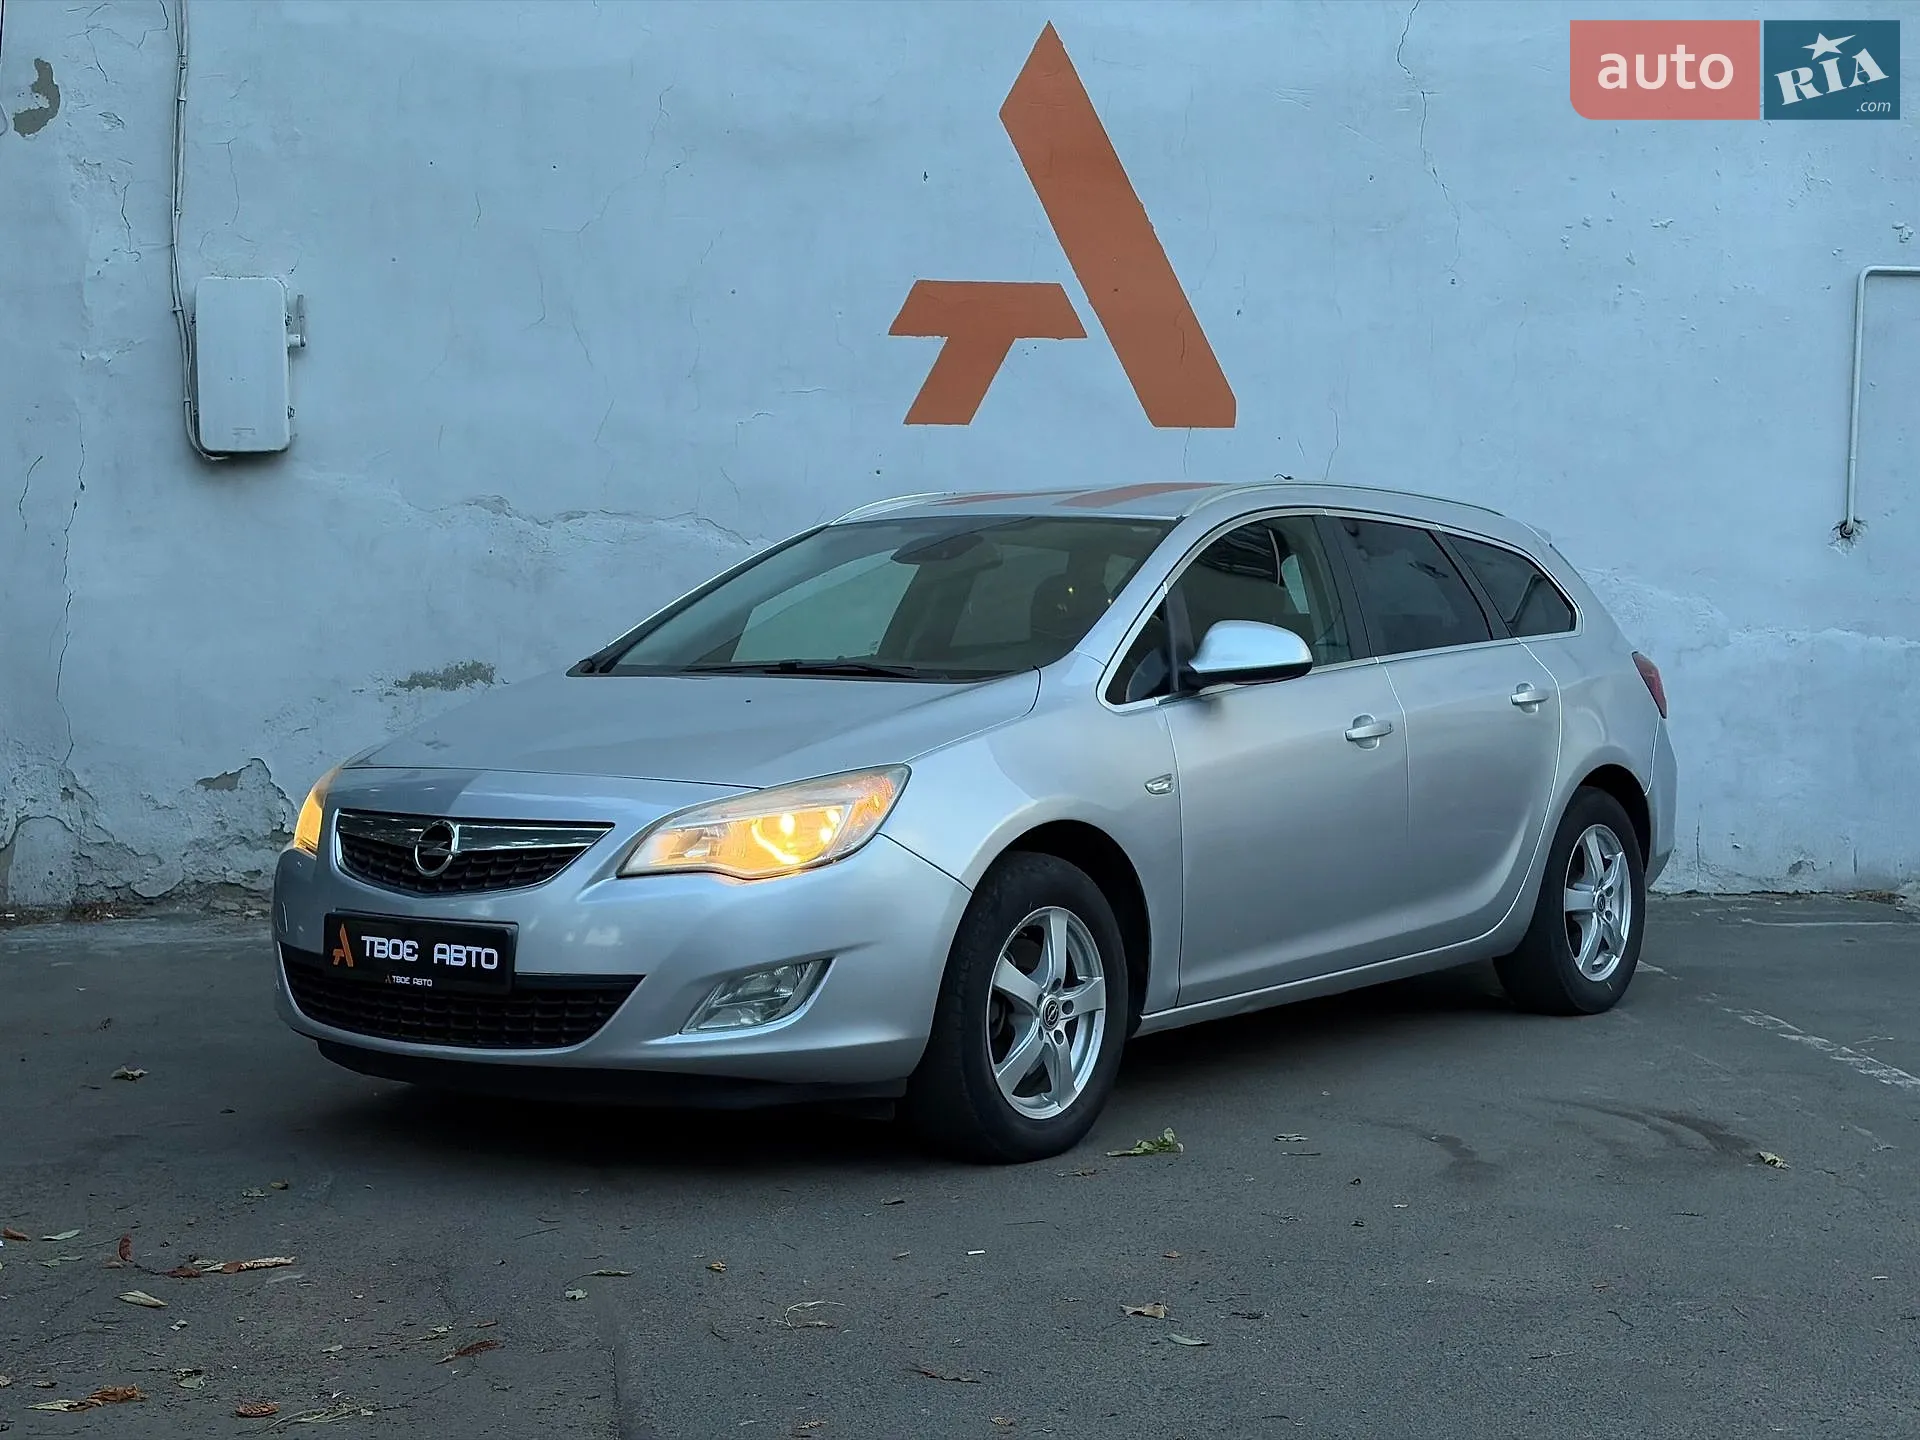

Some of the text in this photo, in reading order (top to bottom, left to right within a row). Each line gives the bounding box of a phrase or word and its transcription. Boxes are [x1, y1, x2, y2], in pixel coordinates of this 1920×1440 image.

[361, 935, 499, 970] ТВОЄ АВТО
[412, 977, 433, 987] АВТО
